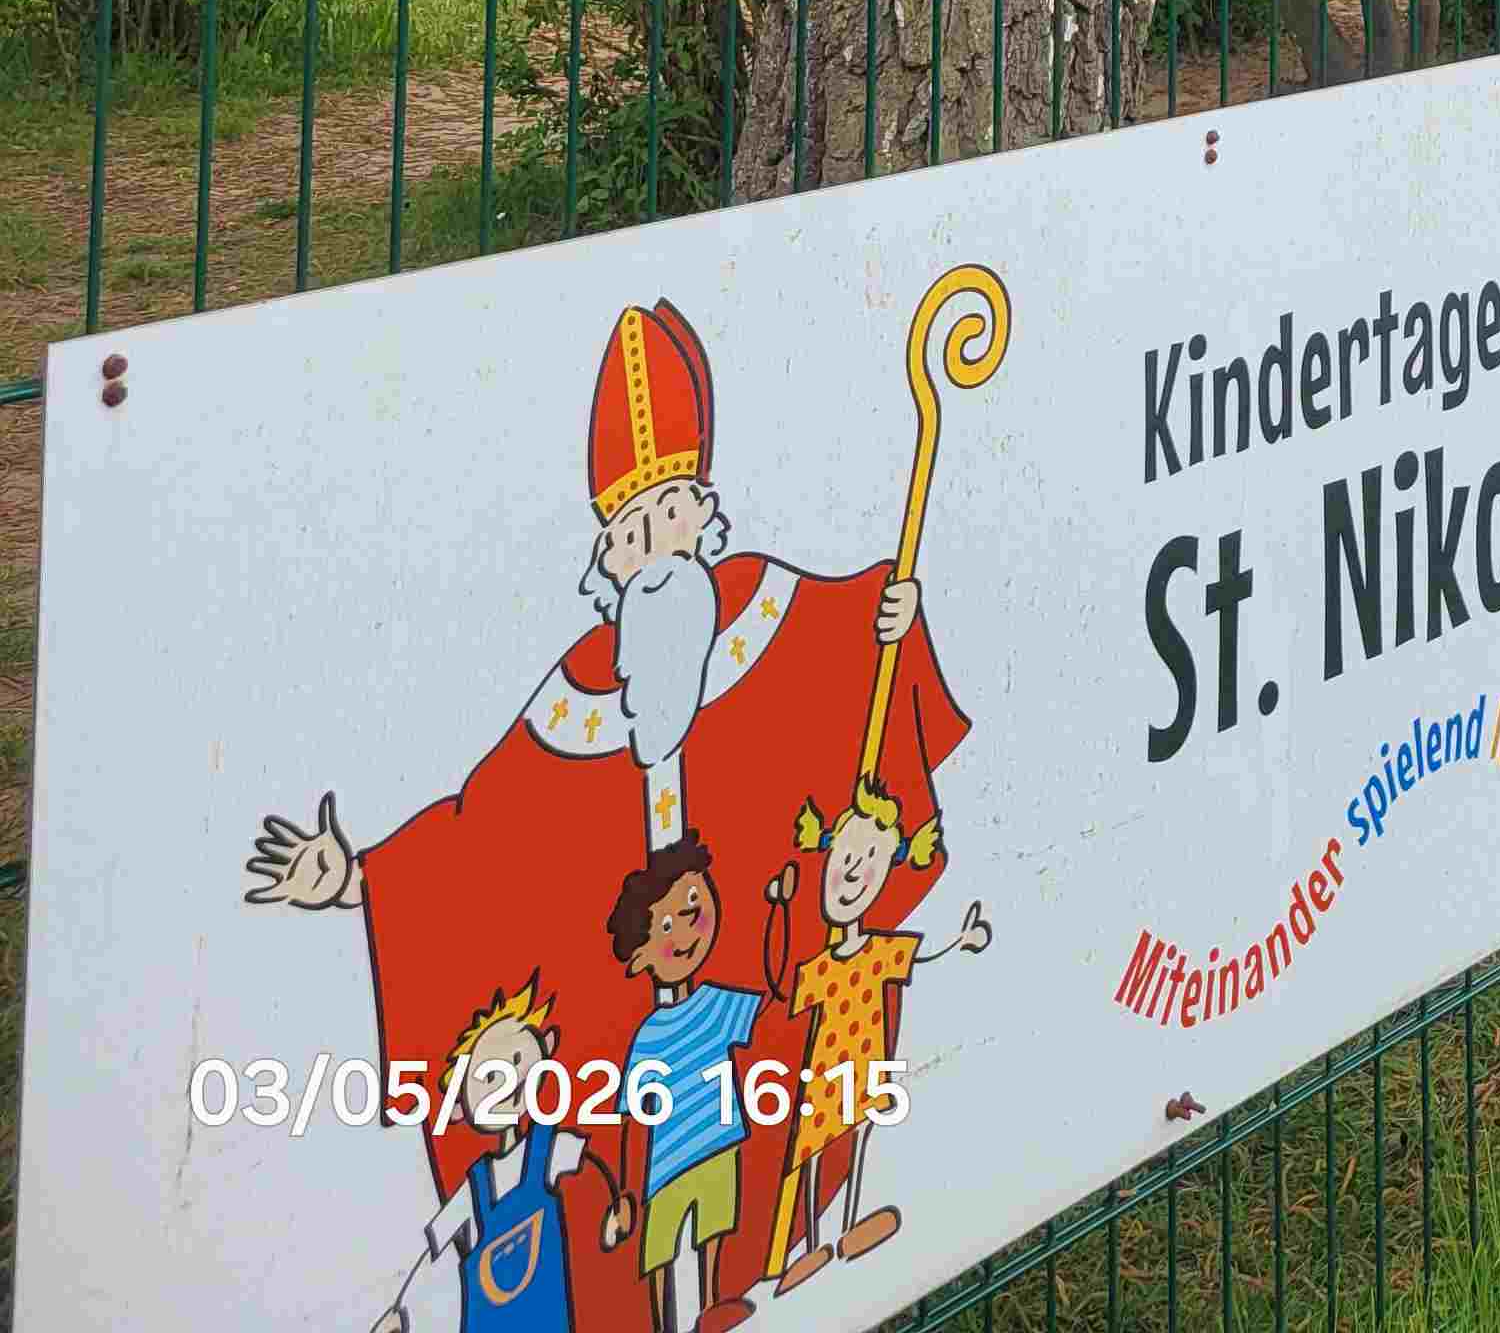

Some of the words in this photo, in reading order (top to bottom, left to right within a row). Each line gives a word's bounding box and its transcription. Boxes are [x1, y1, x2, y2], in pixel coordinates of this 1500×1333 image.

[1145, 530, 1279, 763] St.
[1114, 838, 1344, 1029] Miteinander
[1345, 693, 1487, 847] spielend
